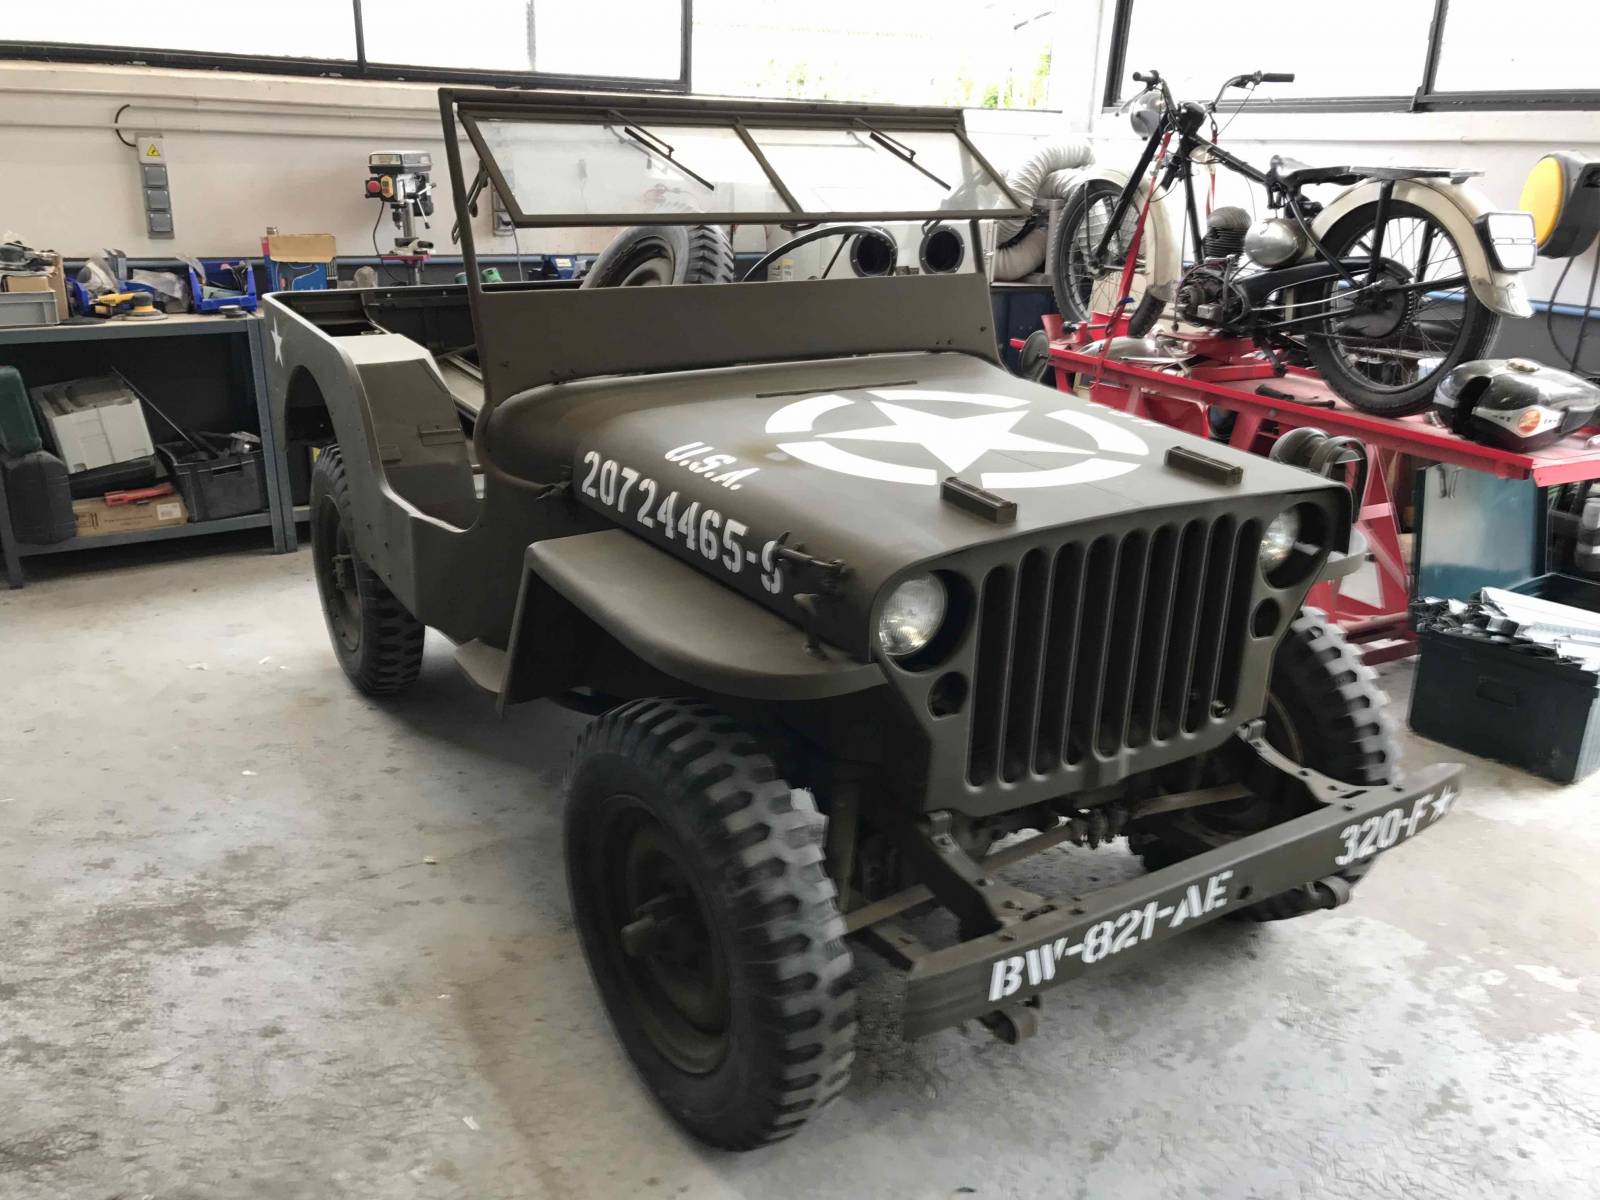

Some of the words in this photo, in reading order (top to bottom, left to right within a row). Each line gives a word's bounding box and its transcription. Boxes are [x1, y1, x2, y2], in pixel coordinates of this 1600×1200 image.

[664, 441, 761, 491] U.S.A.
[1335, 793, 1434, 865] 320-F
[988, 870, 1233, 1001] BW-821-AE
